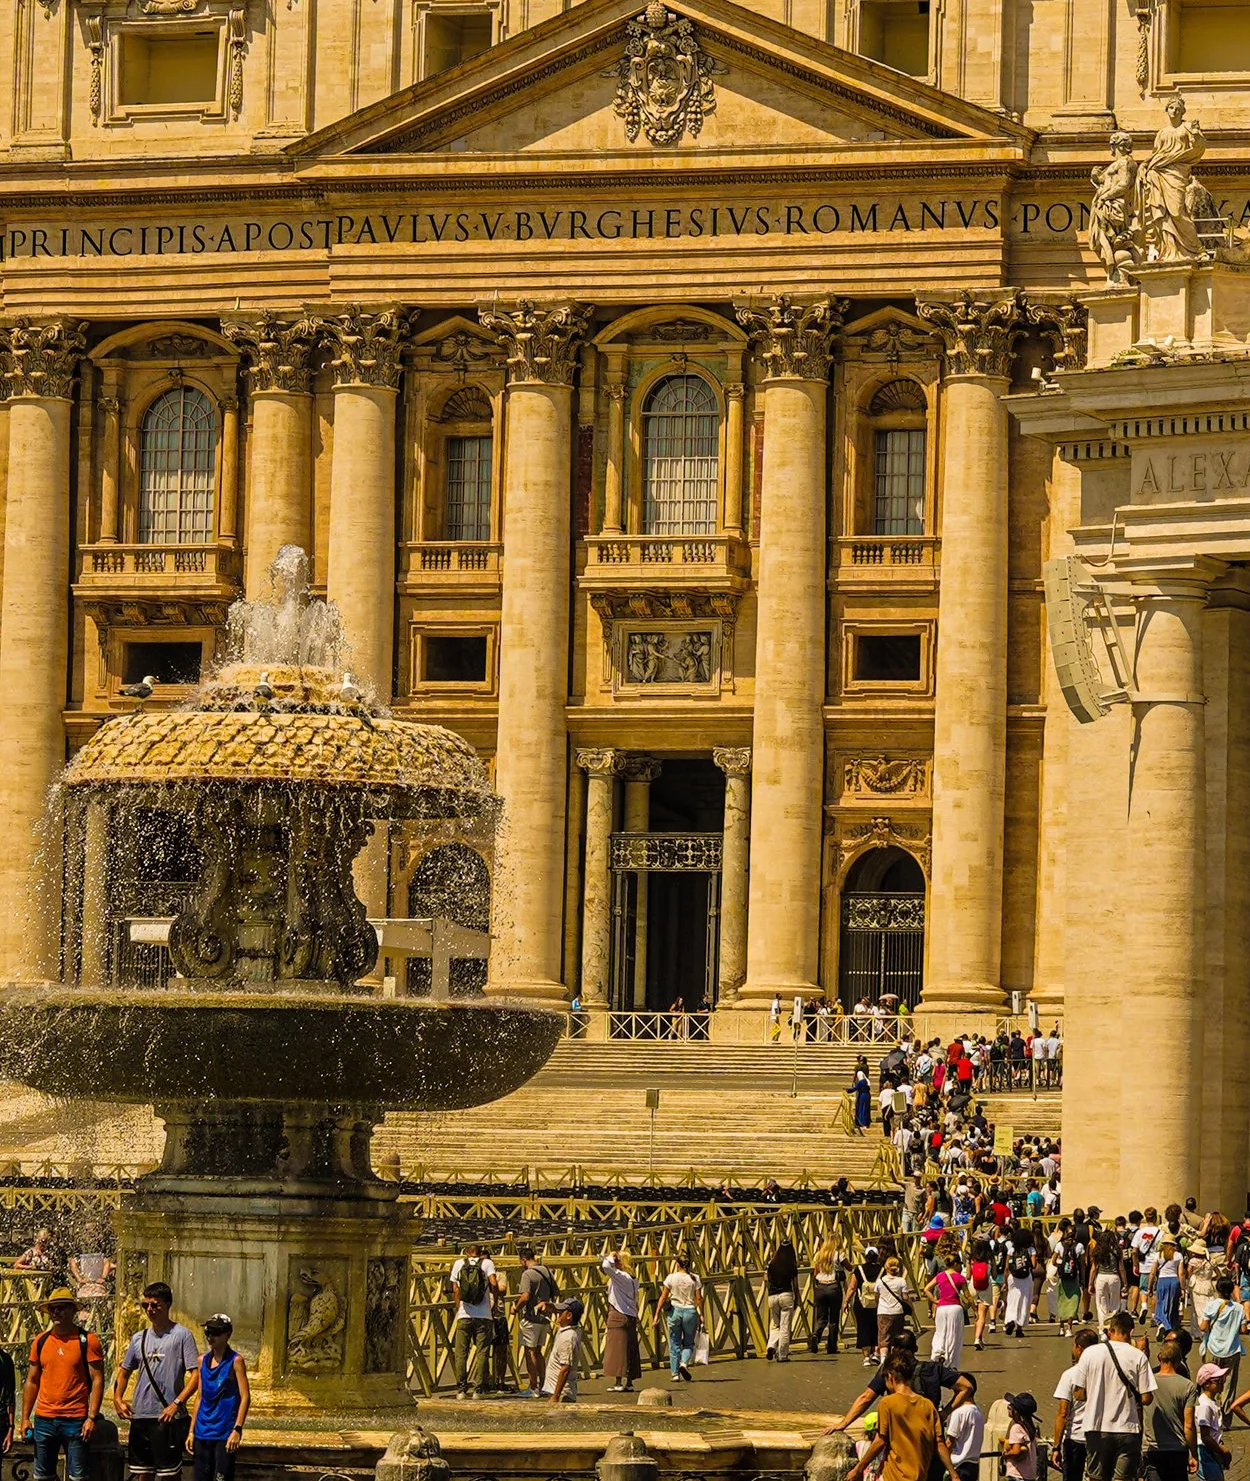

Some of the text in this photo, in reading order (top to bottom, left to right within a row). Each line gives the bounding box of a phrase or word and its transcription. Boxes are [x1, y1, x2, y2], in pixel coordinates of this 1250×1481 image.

[9, 225, 206, 259] PRINCIPIS
[216, 220, 333, 252] APOST
[336, 213, 470, 244] PAVLVS
[479, 212, 505, 241] V
[514, 206, 770, 241] BVRGHESIVS
[784, 199, 998, 235] ROMANVS
[1019, 202, 1097, 233] PON
